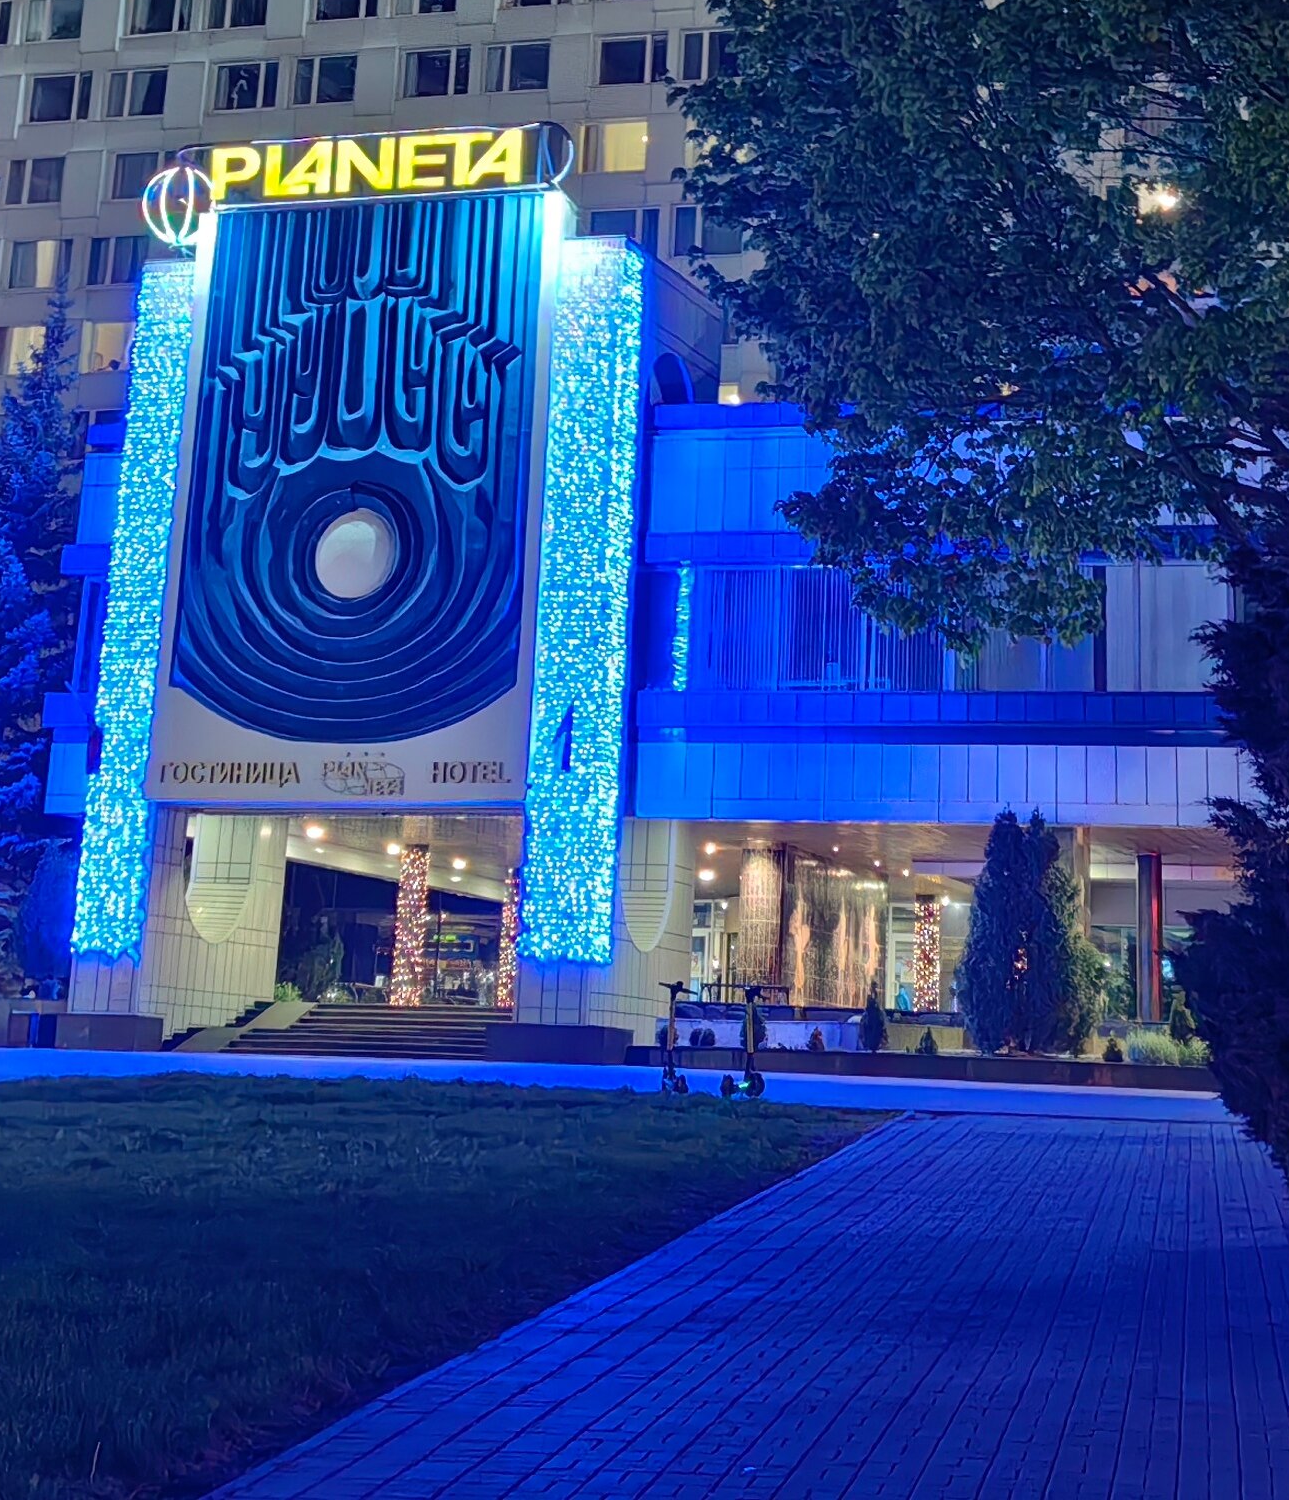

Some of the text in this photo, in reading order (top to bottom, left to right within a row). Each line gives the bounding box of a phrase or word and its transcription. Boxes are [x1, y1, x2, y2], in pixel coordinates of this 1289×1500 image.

[211, 127, 523, 200] PLANETA
[160, 761, 301, 788] ГОСТИНИЦА
[431, 761, 512, 784] HOTEL
